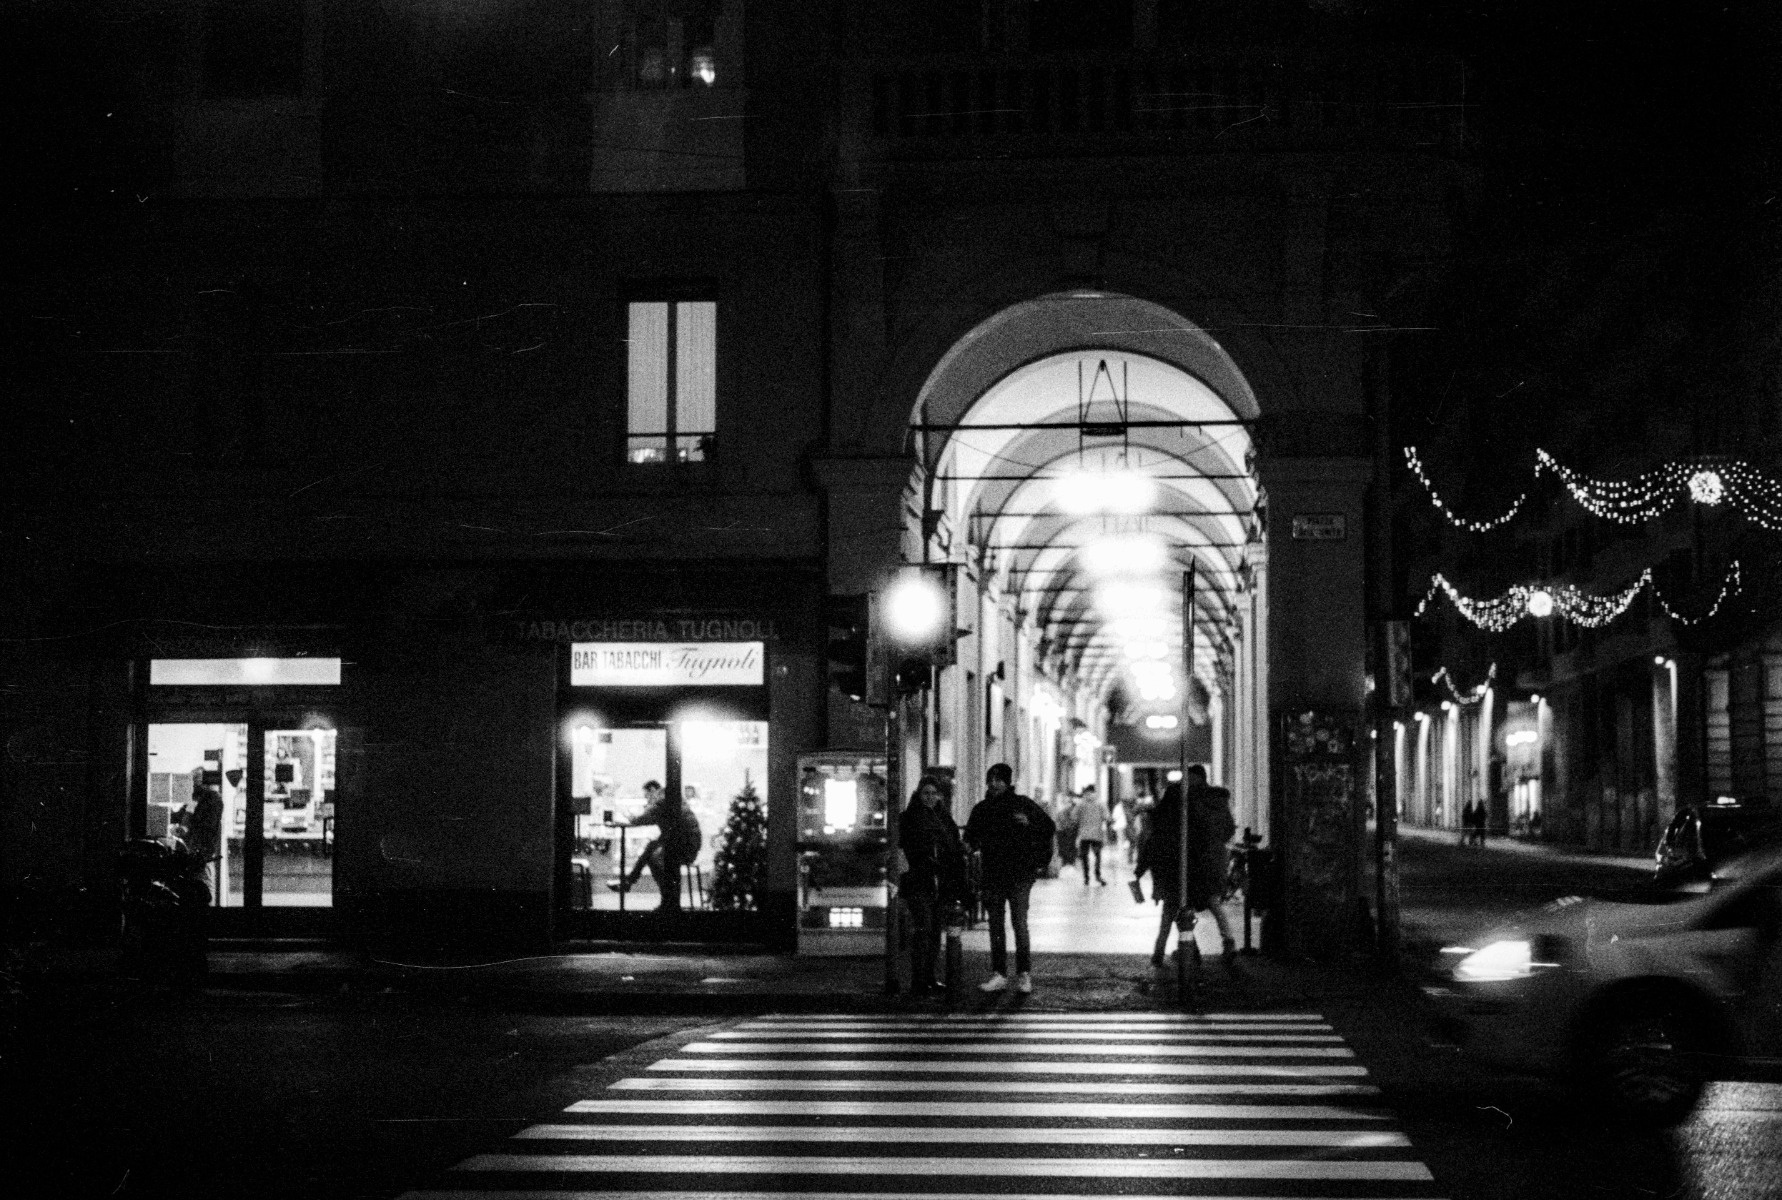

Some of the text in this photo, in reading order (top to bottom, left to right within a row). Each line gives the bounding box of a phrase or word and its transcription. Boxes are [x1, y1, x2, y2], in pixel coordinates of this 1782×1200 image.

[517, 619, 775, 640] TABACCHERIA TUGNOLI
[573, 647, 759, 678] BAR TABACCHI Tugnoli
